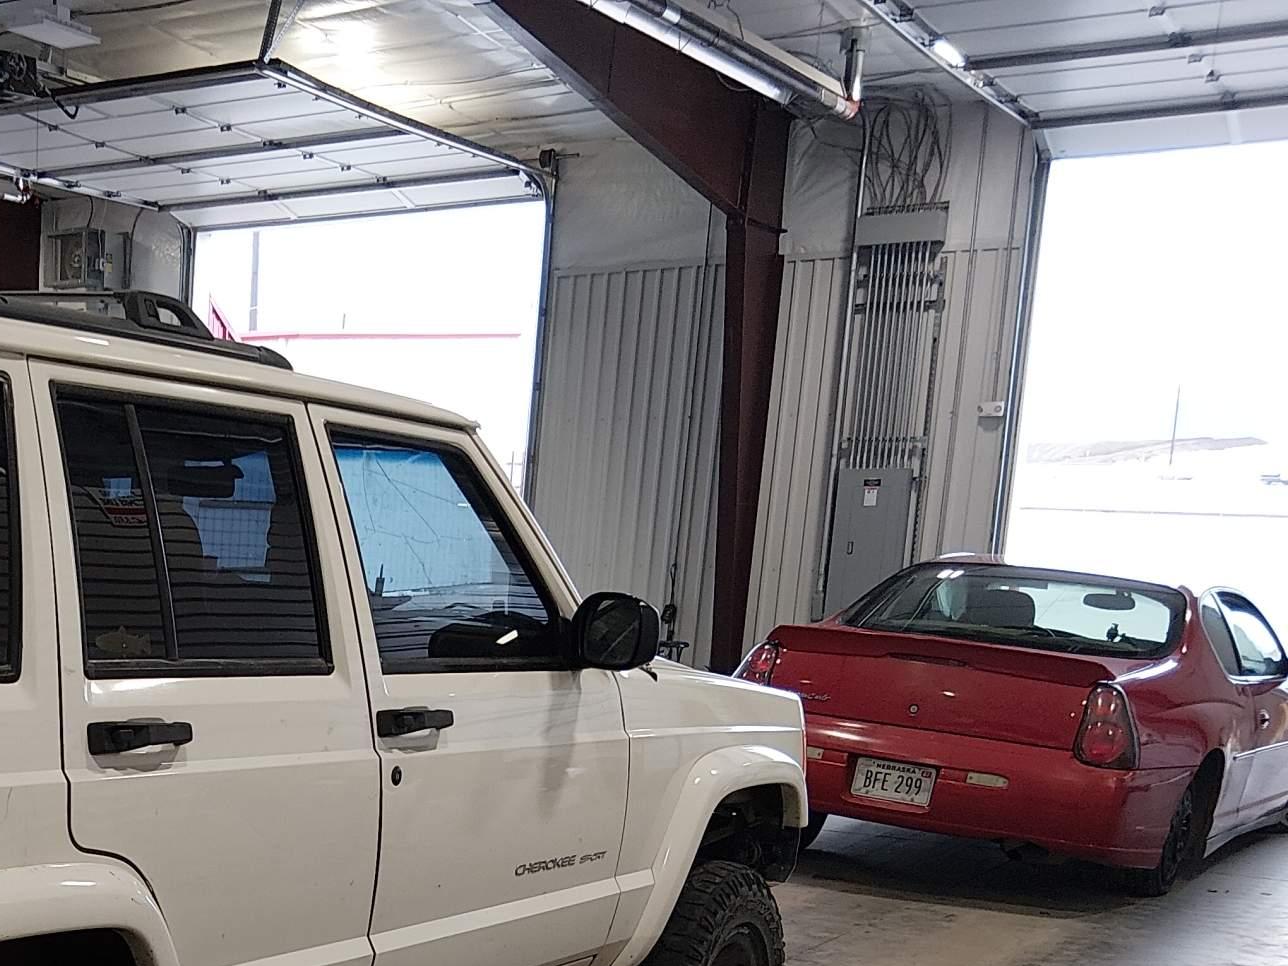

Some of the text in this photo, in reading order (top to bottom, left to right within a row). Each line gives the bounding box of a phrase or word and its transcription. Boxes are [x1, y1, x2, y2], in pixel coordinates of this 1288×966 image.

[876, 763, 916, 774] NEBRASKA
[863, 769, 922, 796] BFE 299
[515, 855, 577, 876] CHEROKEE
